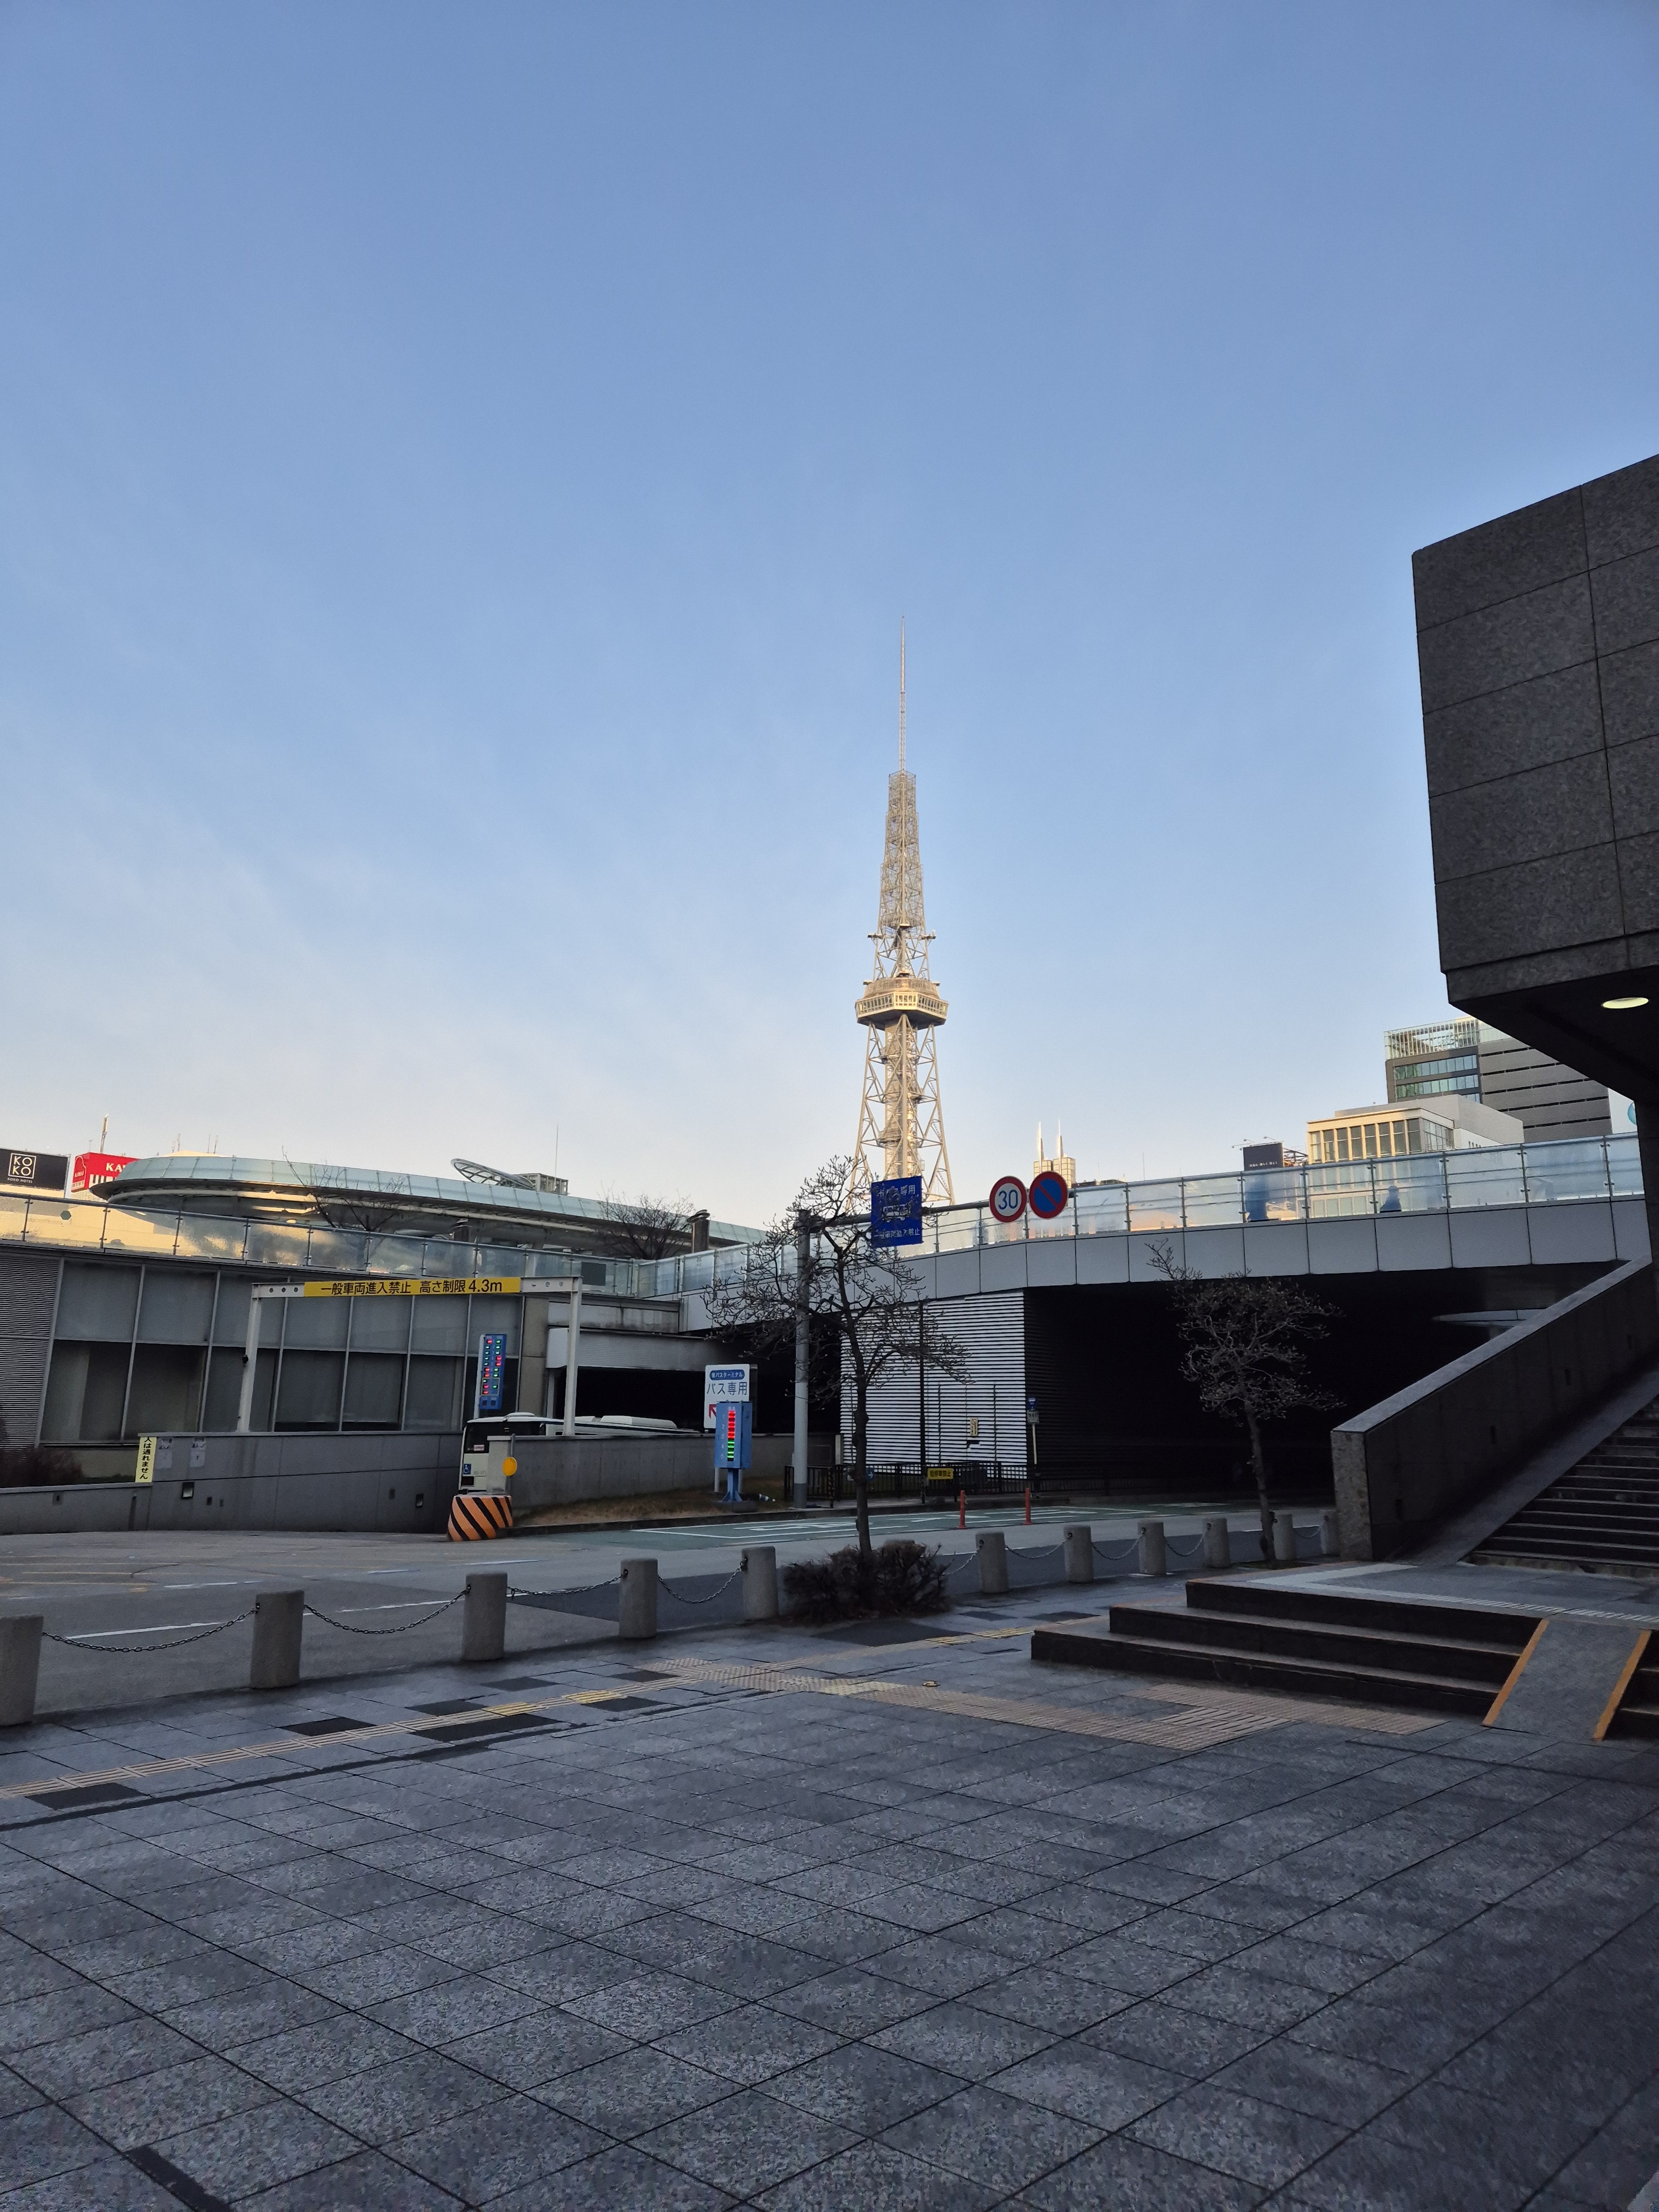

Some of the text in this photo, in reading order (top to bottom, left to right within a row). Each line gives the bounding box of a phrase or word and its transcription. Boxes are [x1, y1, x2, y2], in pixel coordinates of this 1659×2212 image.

[14, 1156, 33, 1166] KO
[106, 1162, 126, 1172] KA
[12, 1165, 31, 1176] KO
[998, 1189, 1018, 1210] 30
[321, 1281, 411, 1295] 一般車両進入禁止
[707, 1382, 747, 1395] バス専用
[139, 1437, 152, 1479] 人は通れません
